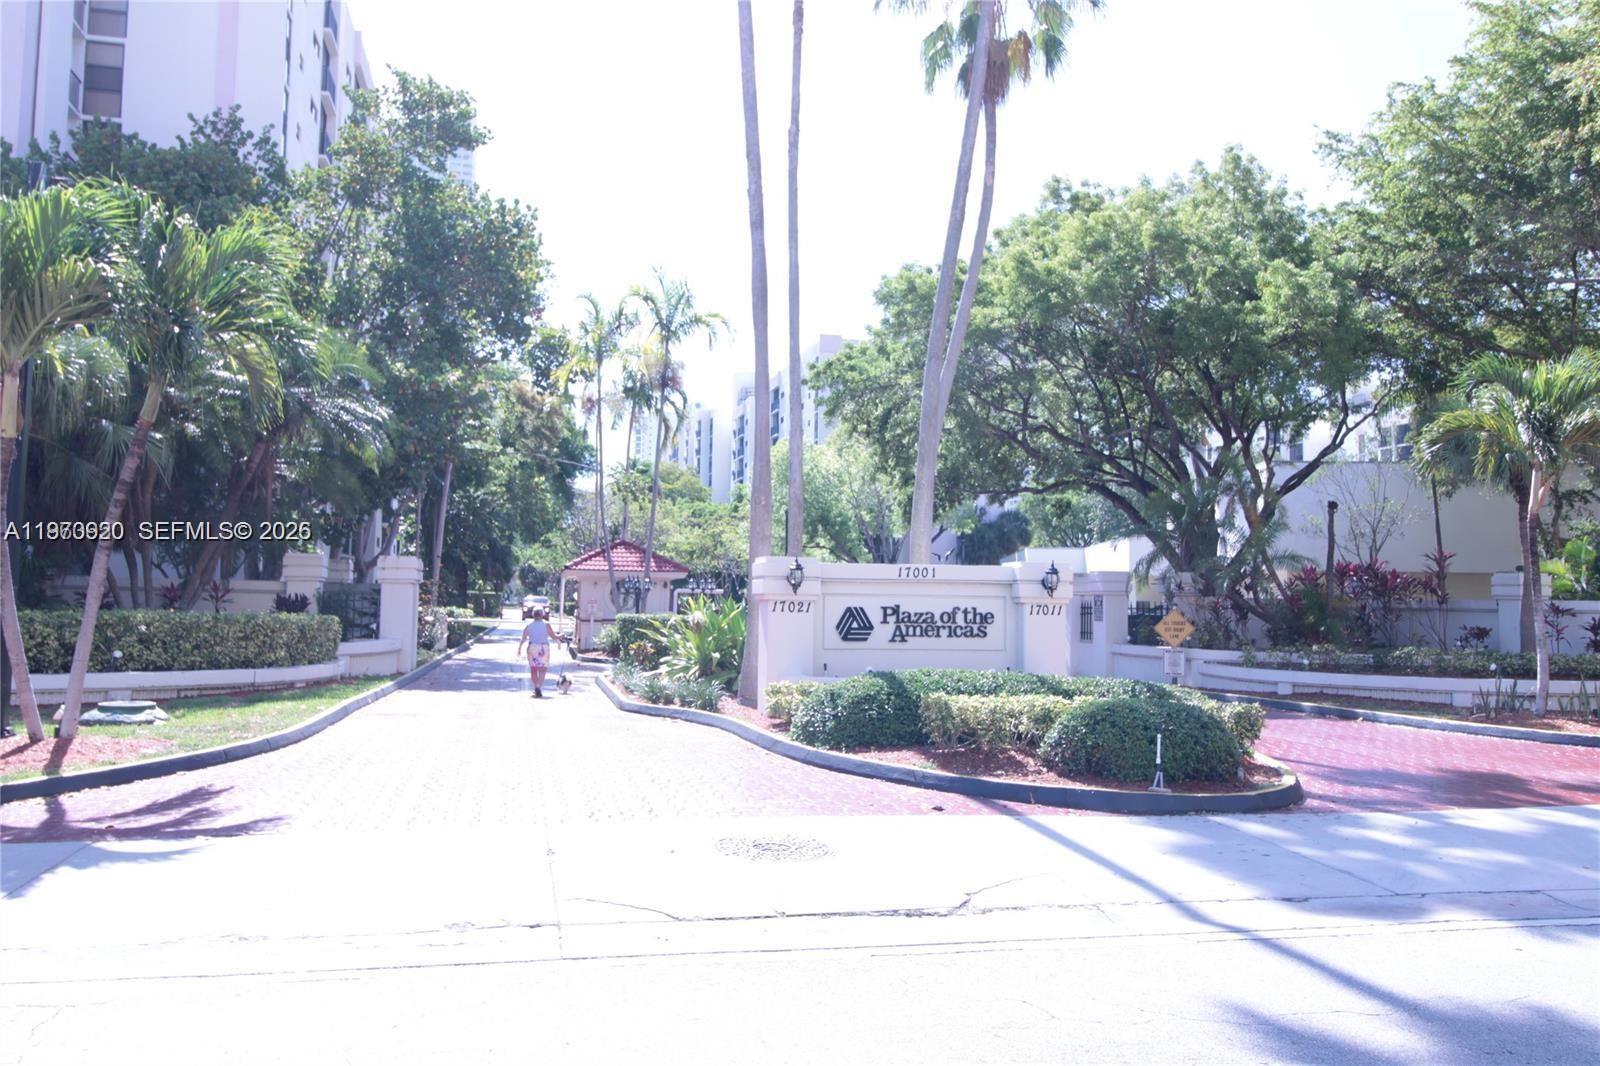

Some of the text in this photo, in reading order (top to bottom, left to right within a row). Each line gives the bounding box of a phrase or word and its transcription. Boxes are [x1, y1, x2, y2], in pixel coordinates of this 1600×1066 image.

[898, 567, 936, 578] 17001
[772, 600, 811, 613] 17021
[1030, 604, 1062, 616] 17011
[880, 604, 995, 625] Plaza of the
[888, 624, 988, 642] Americas
